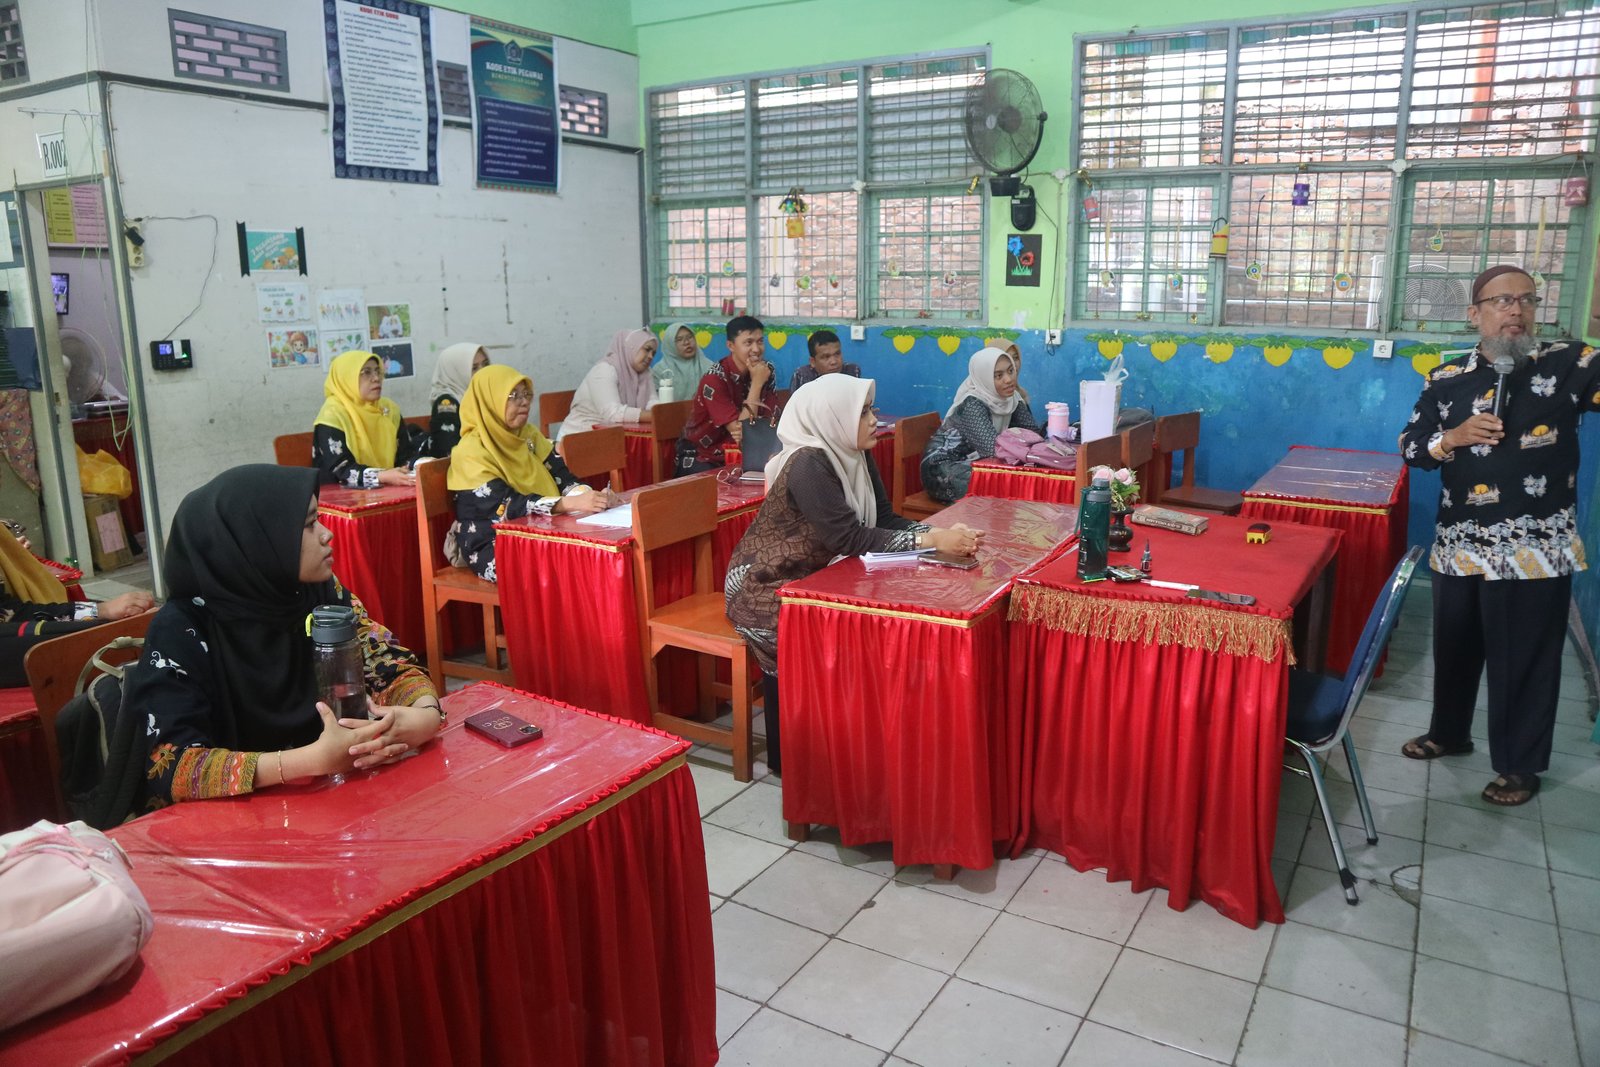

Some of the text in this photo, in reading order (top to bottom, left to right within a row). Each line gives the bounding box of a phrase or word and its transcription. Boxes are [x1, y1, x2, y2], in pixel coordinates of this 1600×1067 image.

[485, 61, 544, 80] KODE ETIK PEGAWAI
